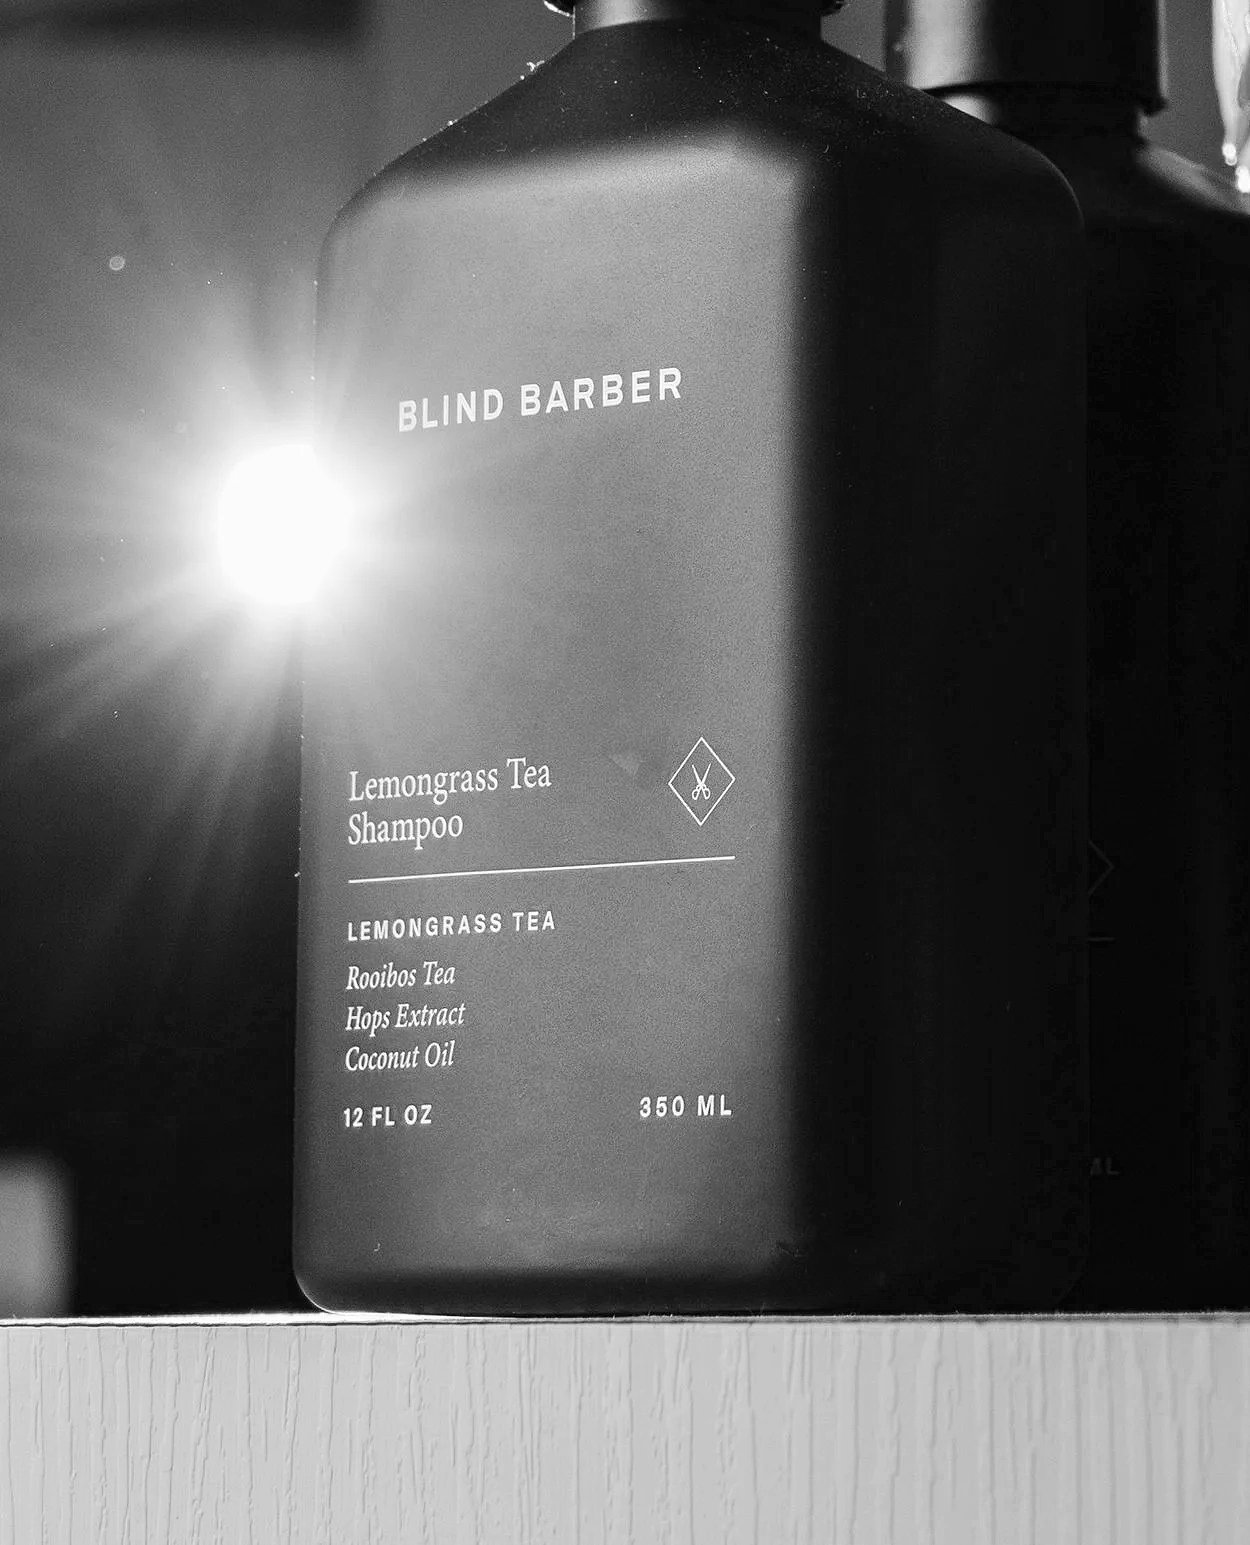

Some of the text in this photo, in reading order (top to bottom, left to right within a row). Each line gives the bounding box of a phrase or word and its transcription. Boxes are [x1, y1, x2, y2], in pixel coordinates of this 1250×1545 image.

[399, 367, 681, 432] BLIND BARBER
[349, 757, 552, 805] Lemongrass Tea
[348, 811, 463, 850] Shampoo
[348, 910, 555, 941] LEMONGRASS TEA
[346, 961, 456, 990] Rooibos Tea
[345, 1002, 466, 1036] Hops Extract
[345, 1040, 455, 1071] Coconut Oil
[343, 1104, 432, 1127] 12 FL OZ
[639, 1094, 732, 1118] 350 ML
